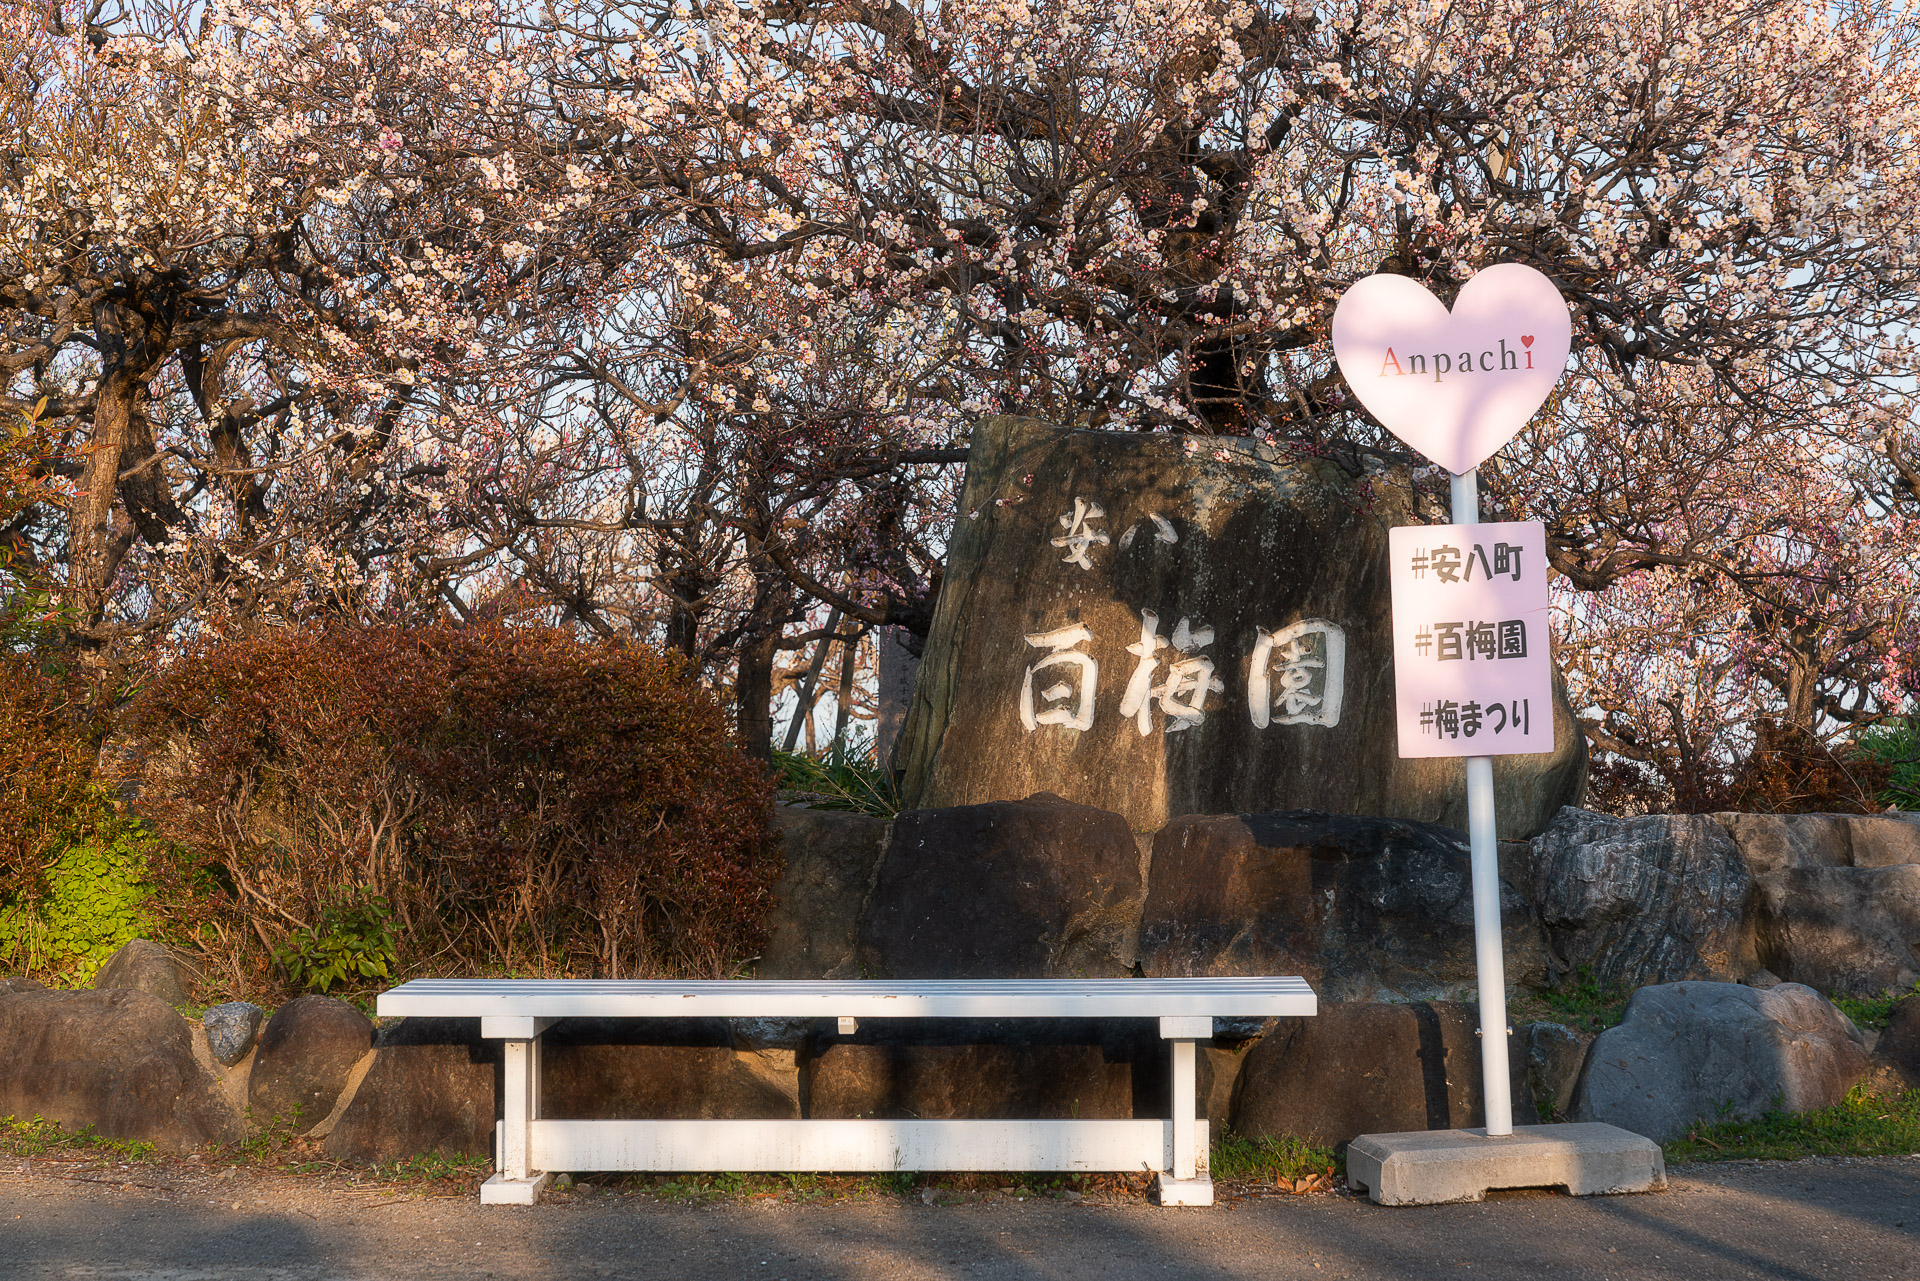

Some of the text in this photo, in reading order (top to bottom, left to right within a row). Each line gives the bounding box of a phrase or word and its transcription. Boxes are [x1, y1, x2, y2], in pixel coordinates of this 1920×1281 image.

[1377, 335, 1535, 383] Anpachi
[1050, 496, 1179, 571] 安八
[1411, 542, 1523, 584] #安八町
[1414, 619, 1528, 662] #百梅園
[1019, 607, 1346, 737] 百梅園
[1420, 698, 1529, 740] #梅まつり
